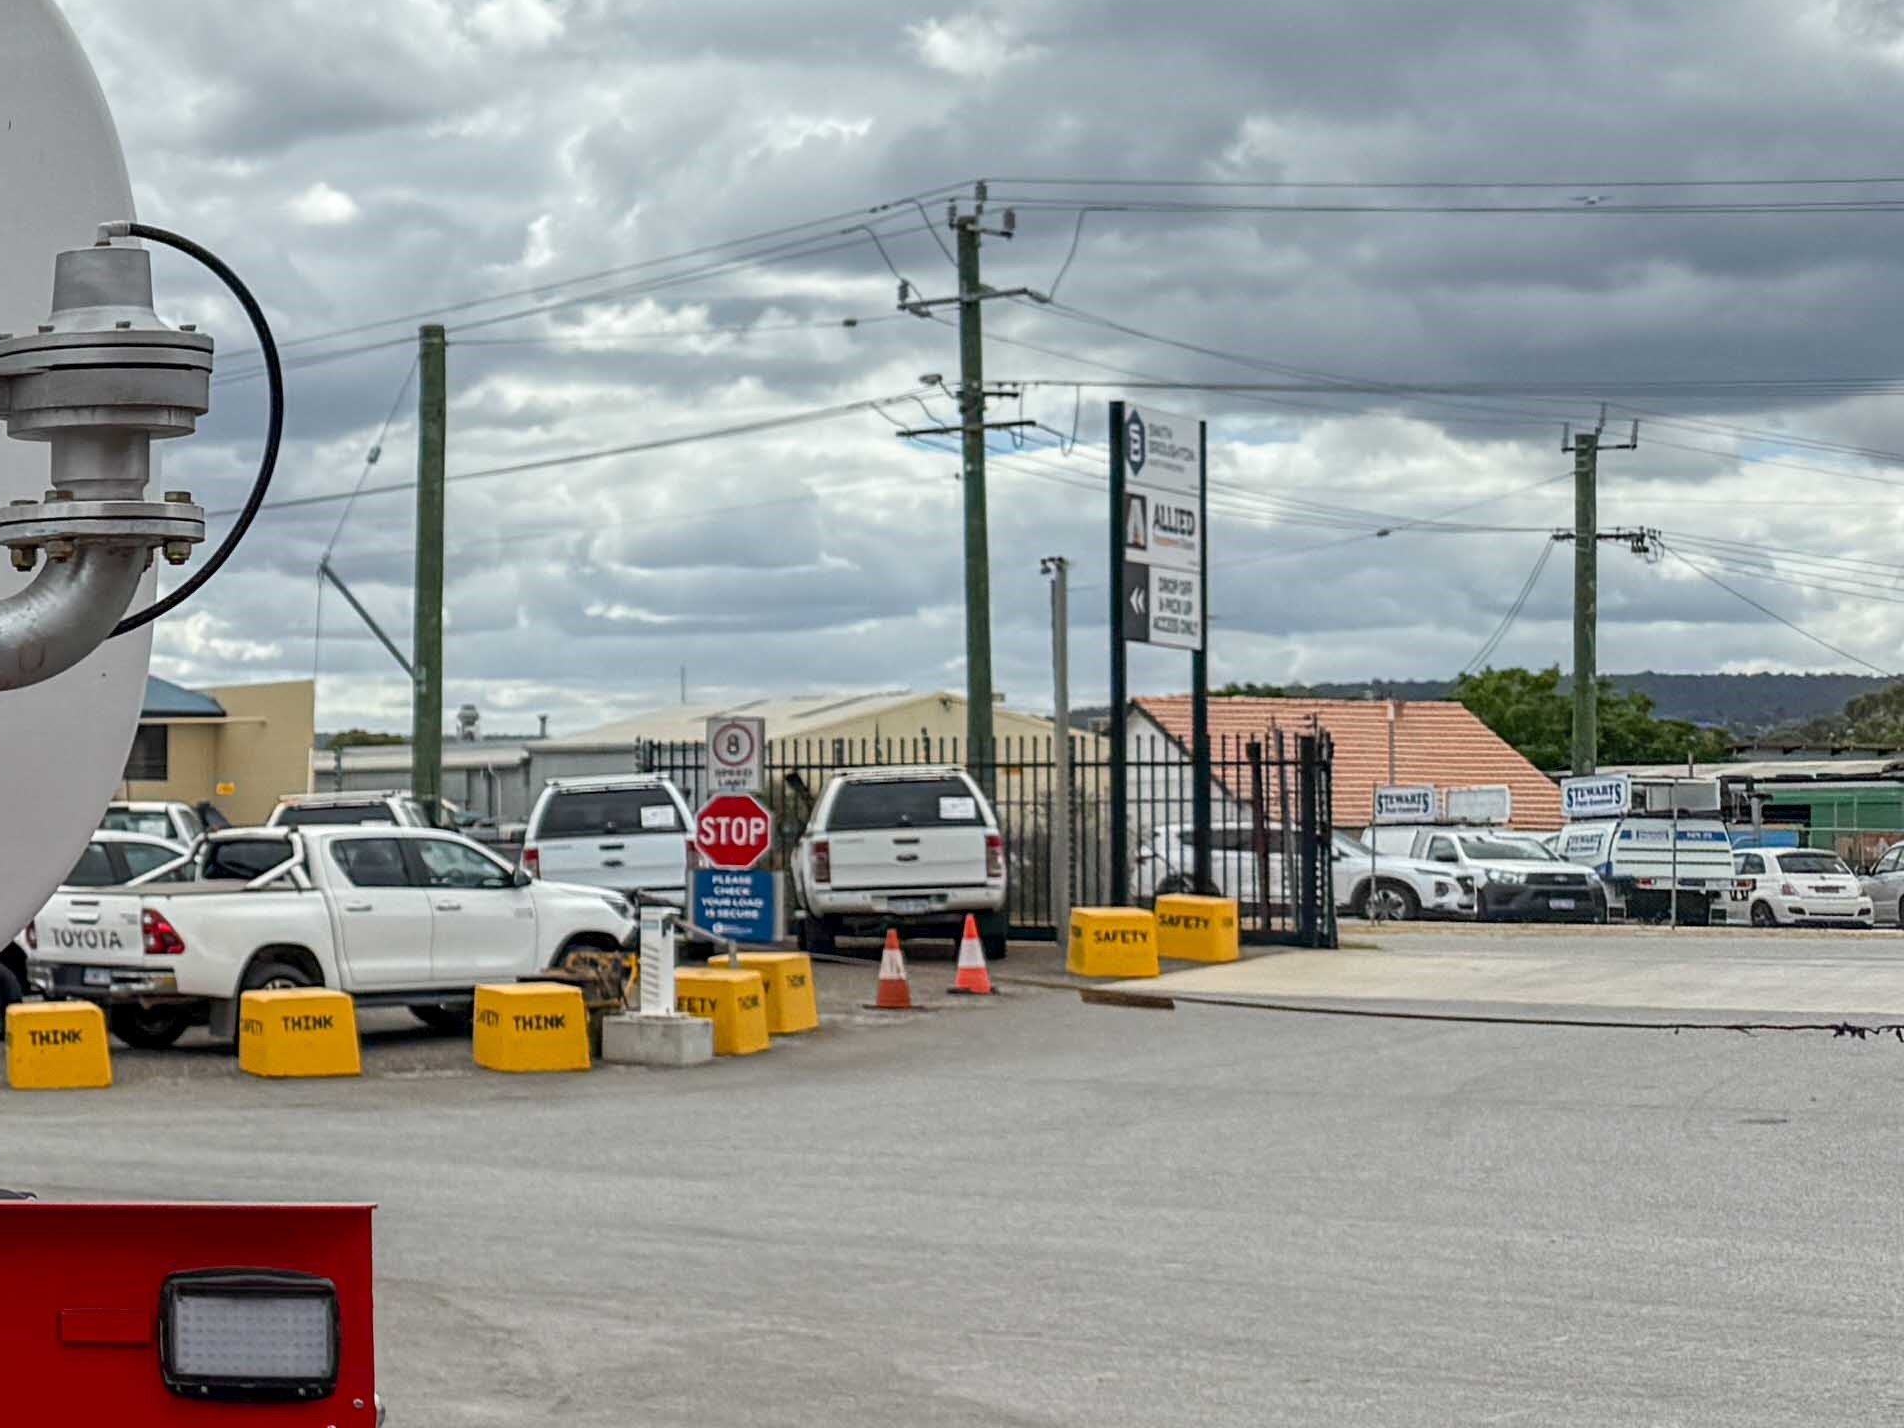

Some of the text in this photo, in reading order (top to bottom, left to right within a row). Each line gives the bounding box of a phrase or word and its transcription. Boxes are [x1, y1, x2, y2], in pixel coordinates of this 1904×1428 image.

[1377, 792, 1429, 814] STEWARTS
[1566, 783, 1622, 808] STEWARTS
[699, 816, 766, 846] STOP
[711, 875, 753, 885] PLEASE
[713, 886, 751, 897] CHECK
[701, 897, 764, 908] YOUR LOAD
[717, 908, 759, 919] SECURE
[1158, 913, 1211, 930] SAFETY
[51, 928, 123, 949] TOYOTA
[1093, 929, 1148, 944] SAFETY
[677, 997, 718, 1013] FETY
[282, 1014, 334, 1032] THINK
[513, 1014, 566, 1033] THINK
[29, 1029, 83, 1046] THINK
